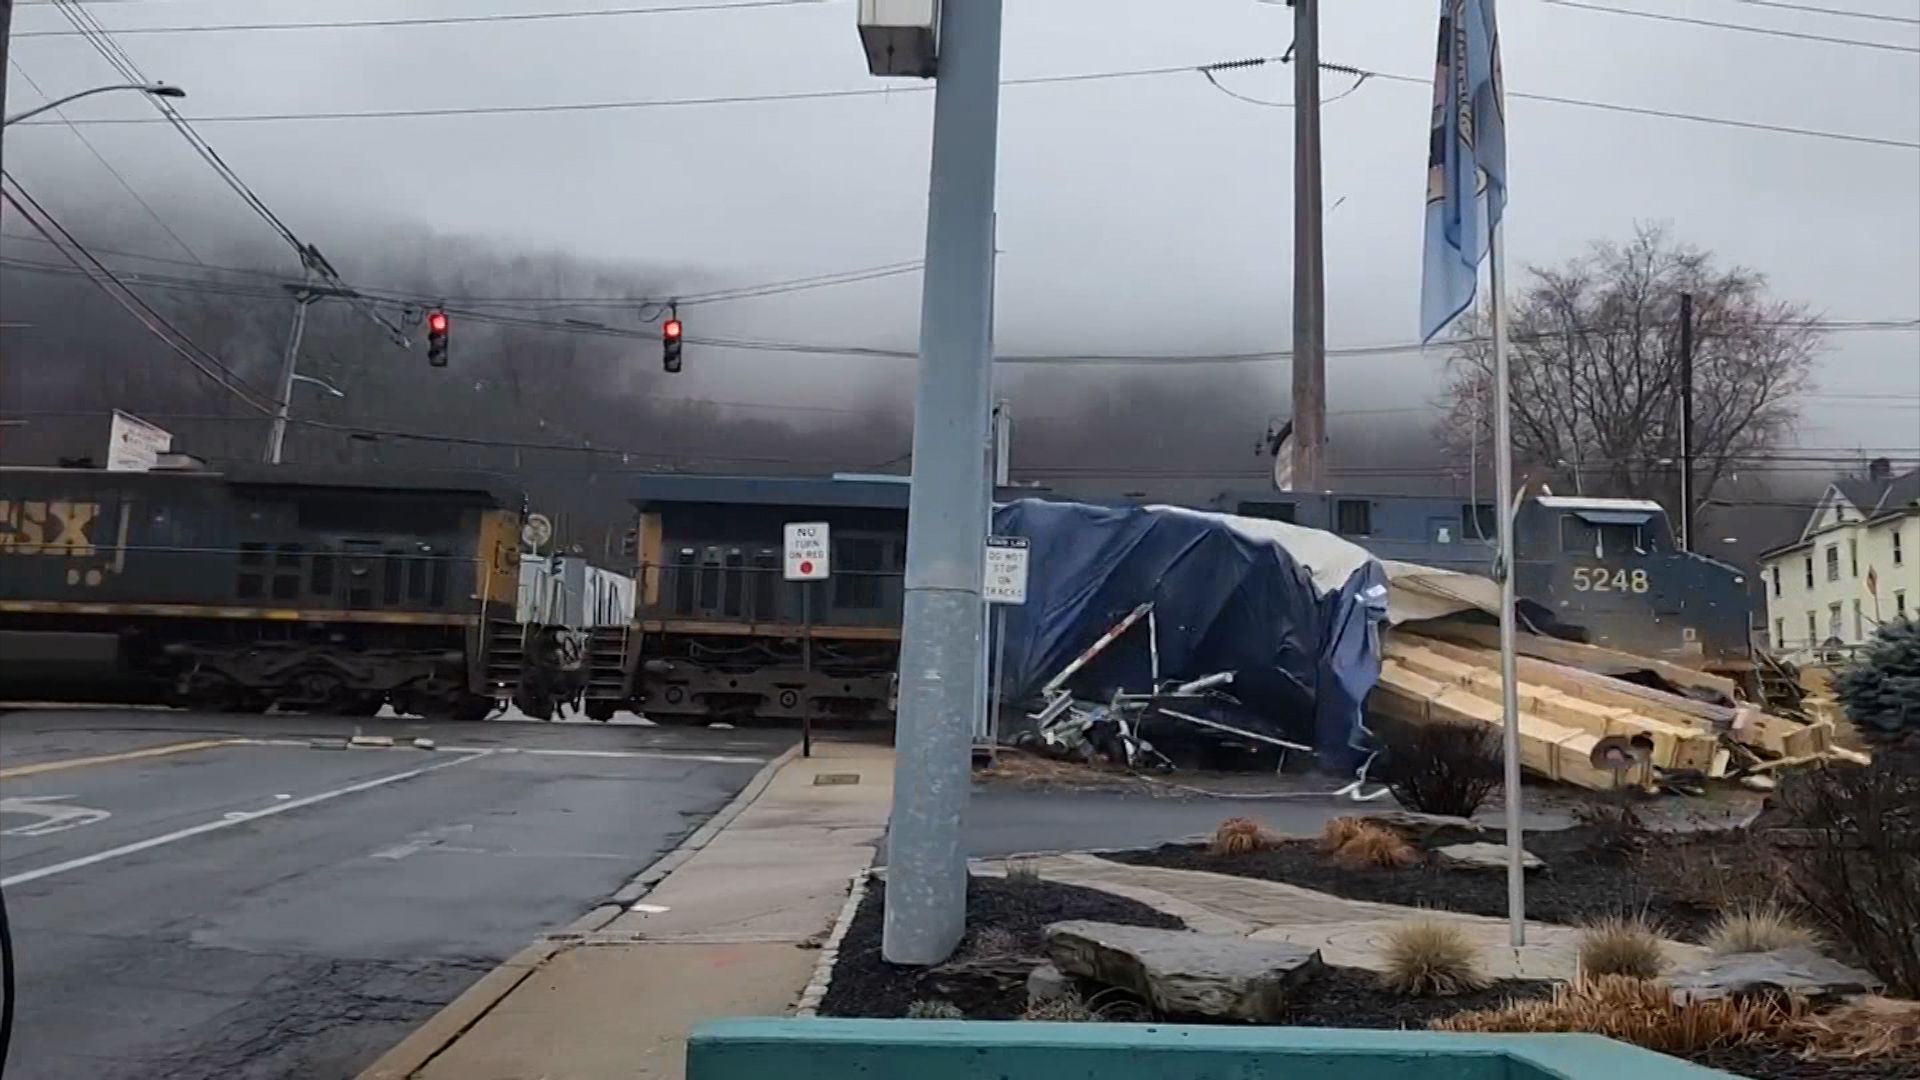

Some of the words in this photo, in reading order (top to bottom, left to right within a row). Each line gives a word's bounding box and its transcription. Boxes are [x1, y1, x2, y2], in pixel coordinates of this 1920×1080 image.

[797, 528, 816, 537] NO
[795, 540, 819, 549] TURN
[1573, 566, 1649, 593] 5248
